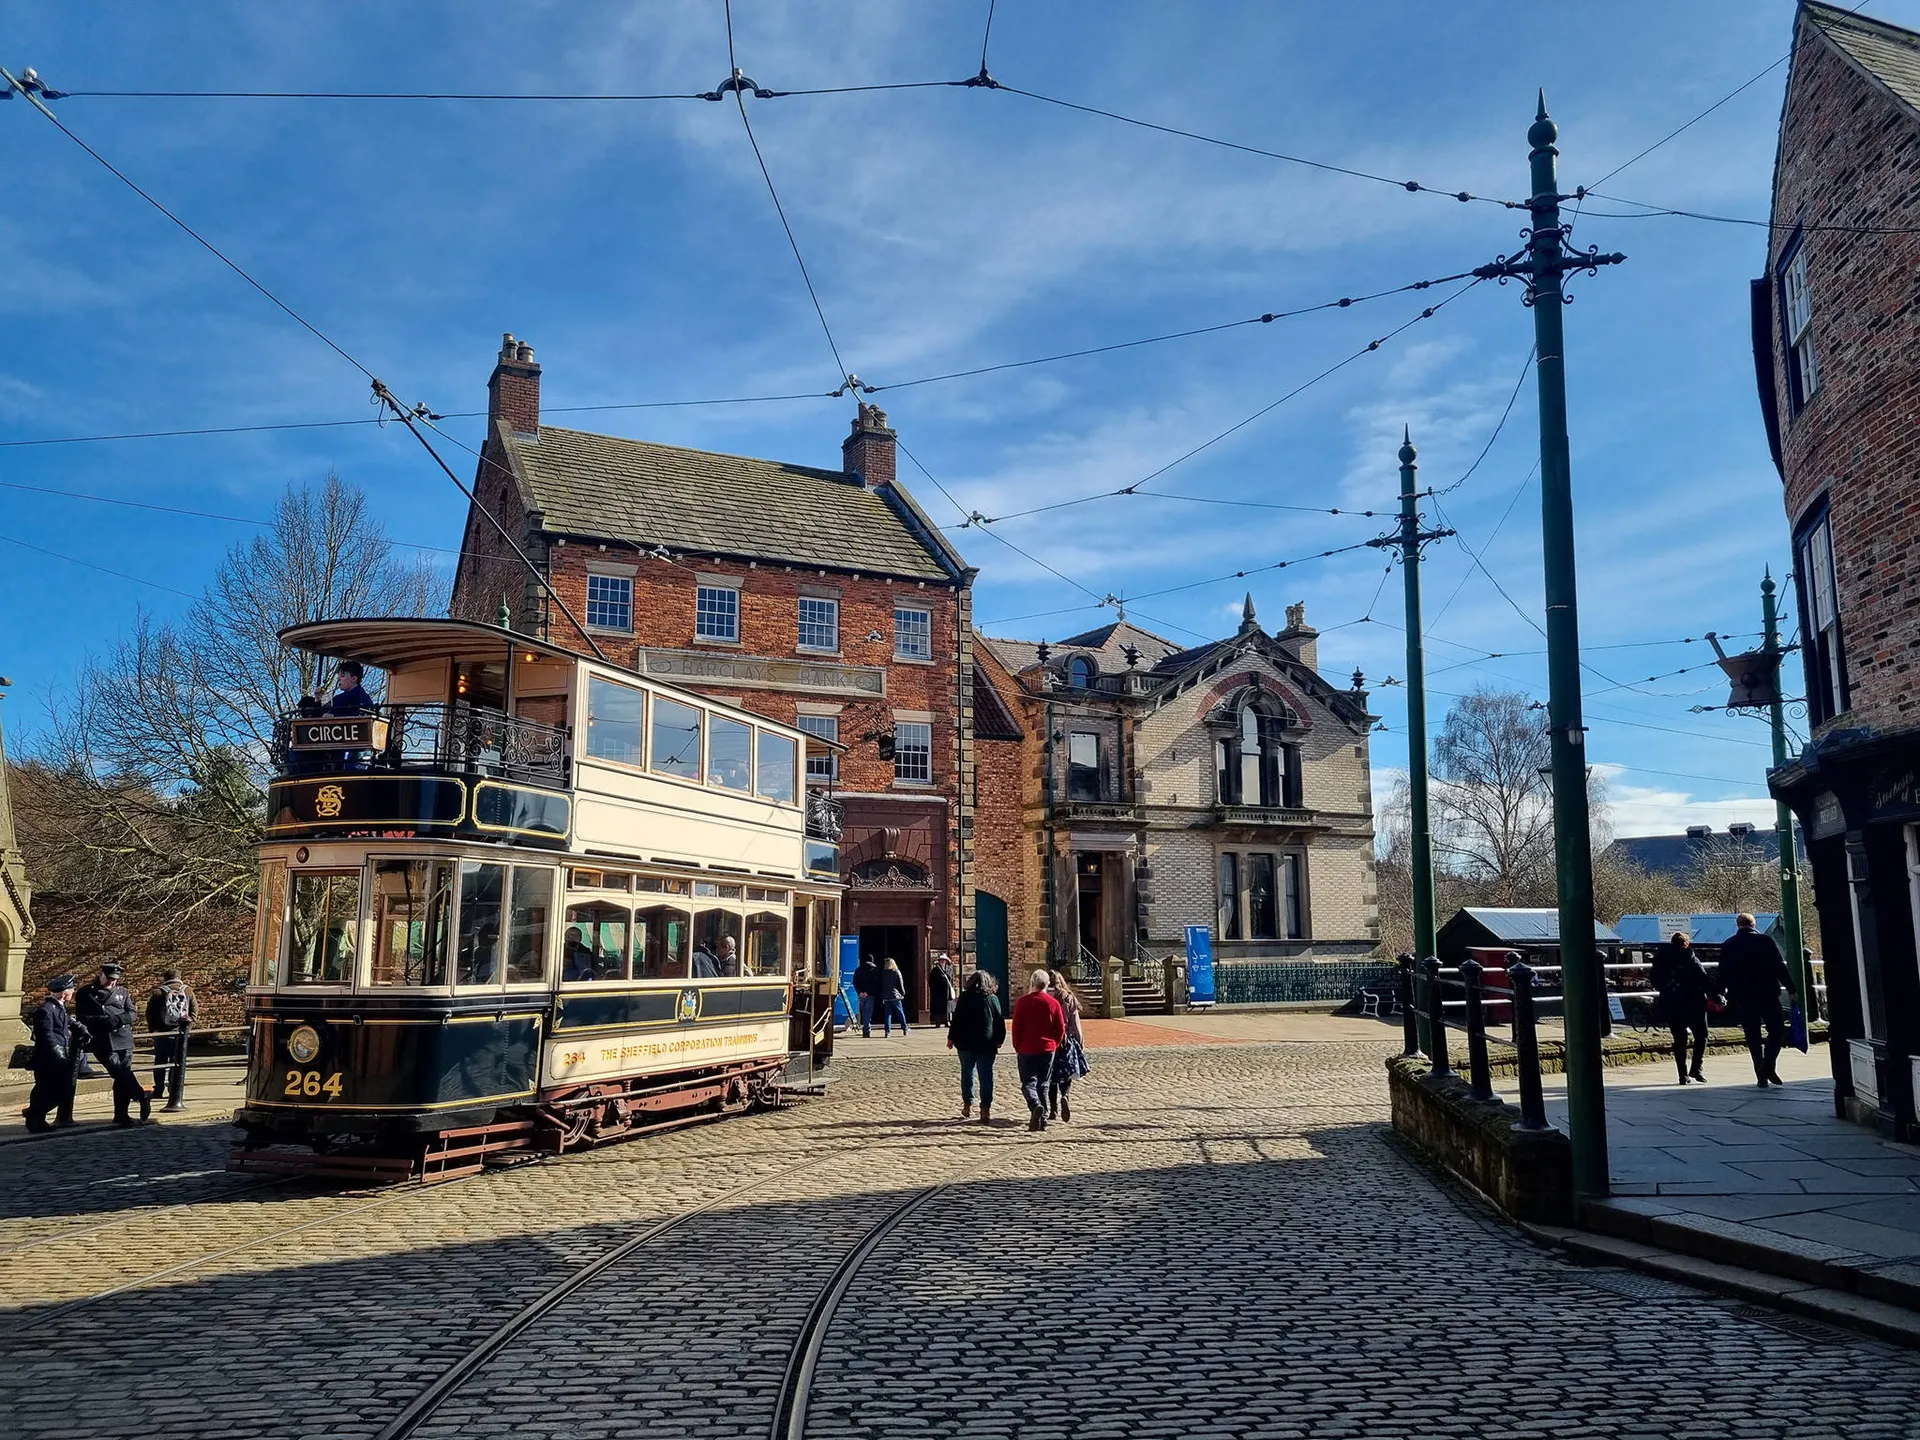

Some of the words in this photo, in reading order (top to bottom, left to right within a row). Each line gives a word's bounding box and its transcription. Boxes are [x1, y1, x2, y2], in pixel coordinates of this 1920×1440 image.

[800, 666, 849, 688] BANK
[308, 725, 359, 741] CIRCLE
[601, 1048, 617, 1061] THE
[620, 1043, 667, 1058] SHEFFIELD
[669, 1037, 722, 1052] CORPORATION
[724, 1033, 758, 1047] TRAMWAYS
[563, 1052, 585, 1066] 264
[284, 1070, 343, 1096] 264
